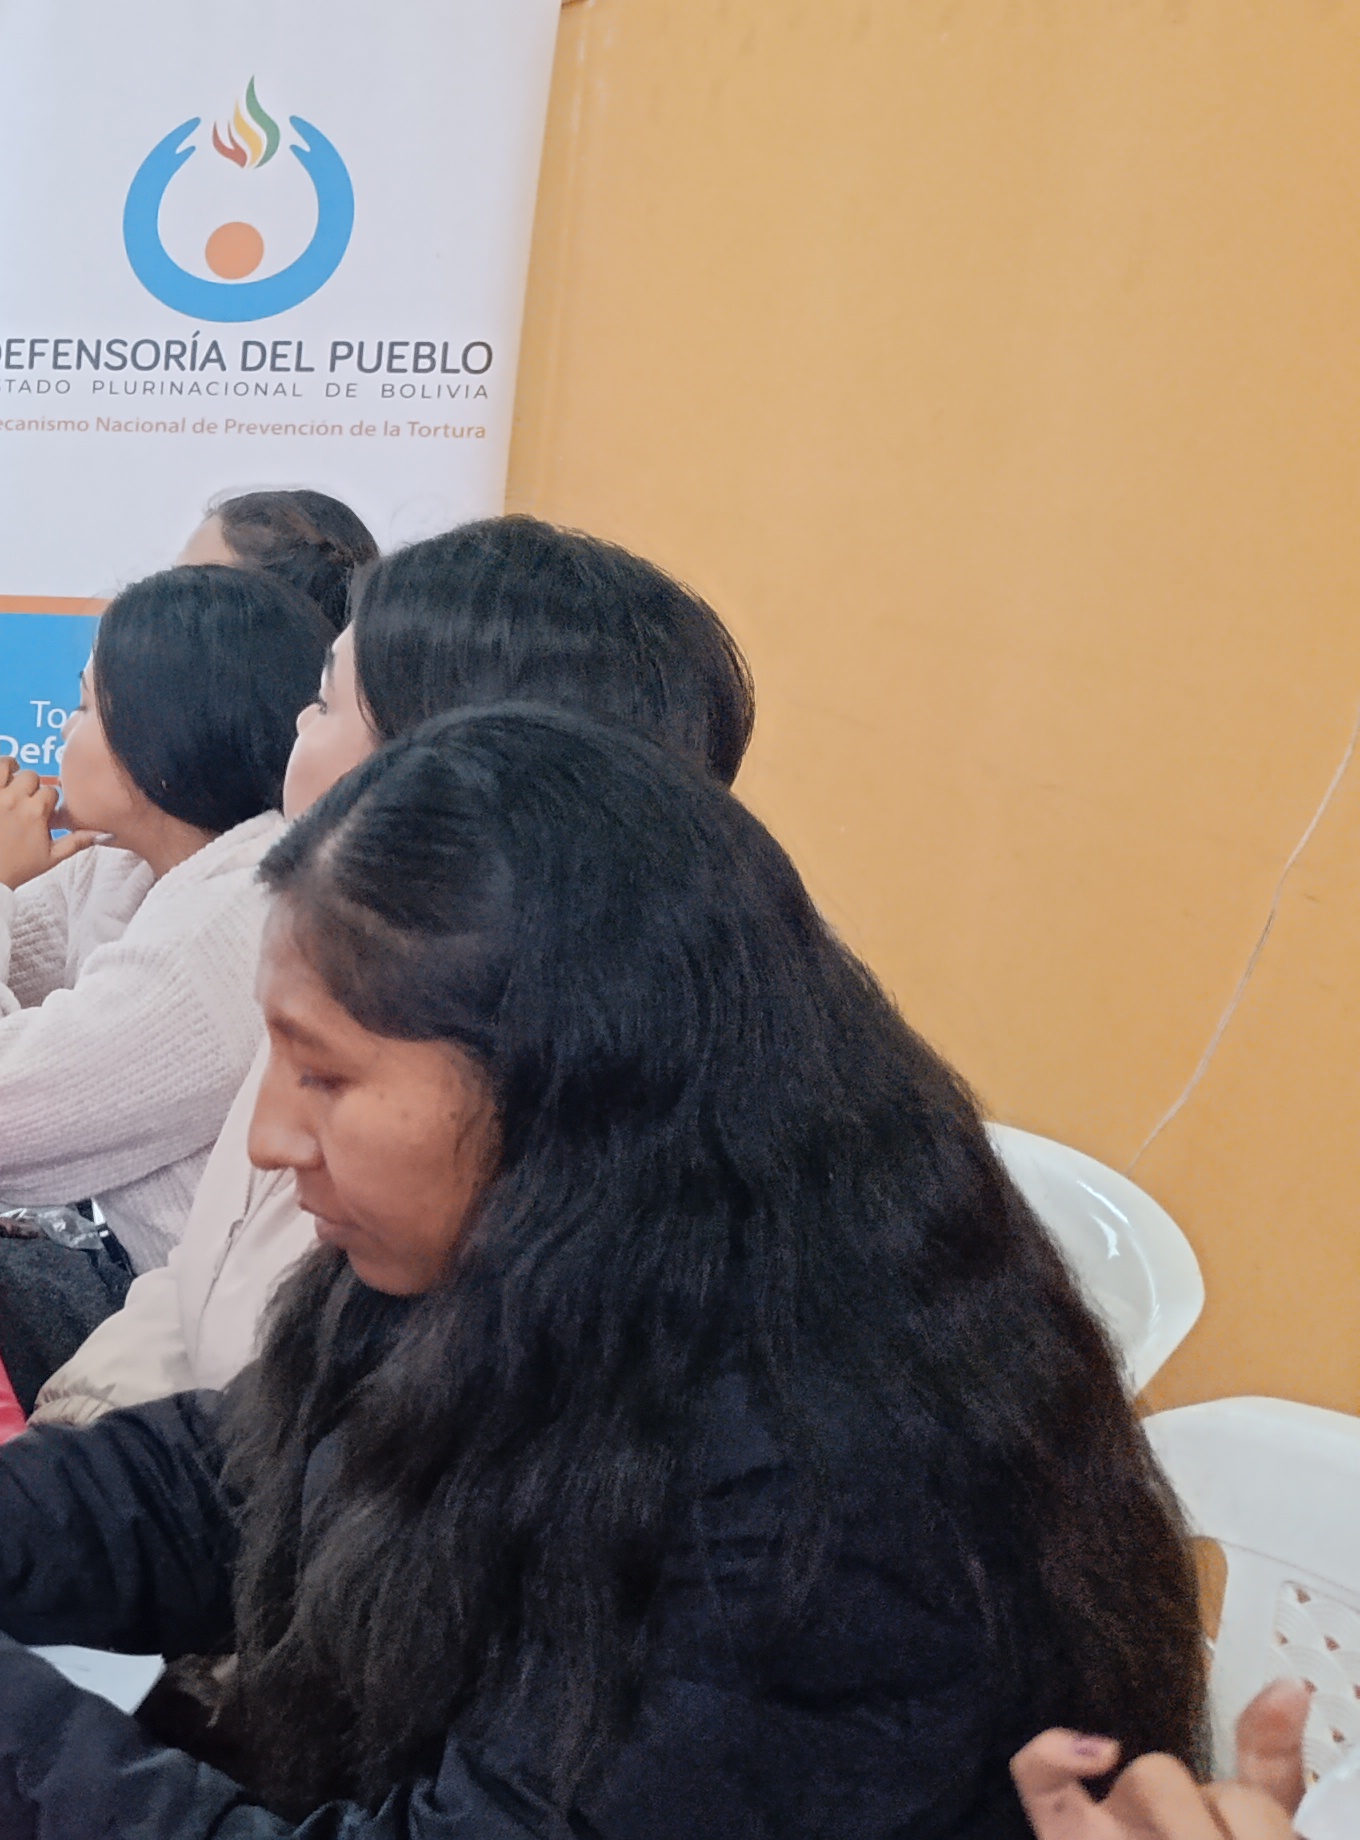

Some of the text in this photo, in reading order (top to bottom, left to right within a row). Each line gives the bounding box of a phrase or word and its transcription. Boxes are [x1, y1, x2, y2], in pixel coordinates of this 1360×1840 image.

[240, 339, 315, 373] DEL
[329, 340, 493, 375] PUEBLO
[92, 379, 303, 397] PLURINACIONAL
[325, 382, 358, 398] DE
[380, 383, 489, 400] BOLIVIA
[95, 416, 186, 434] Nacional
[191, 418, 218, 434] de
[224, 418, 343, 437] Prevención
[349, 419, 377, 437] de
[383, 420, 401, 437] la
[407, 421, 486, 439] Tortura
